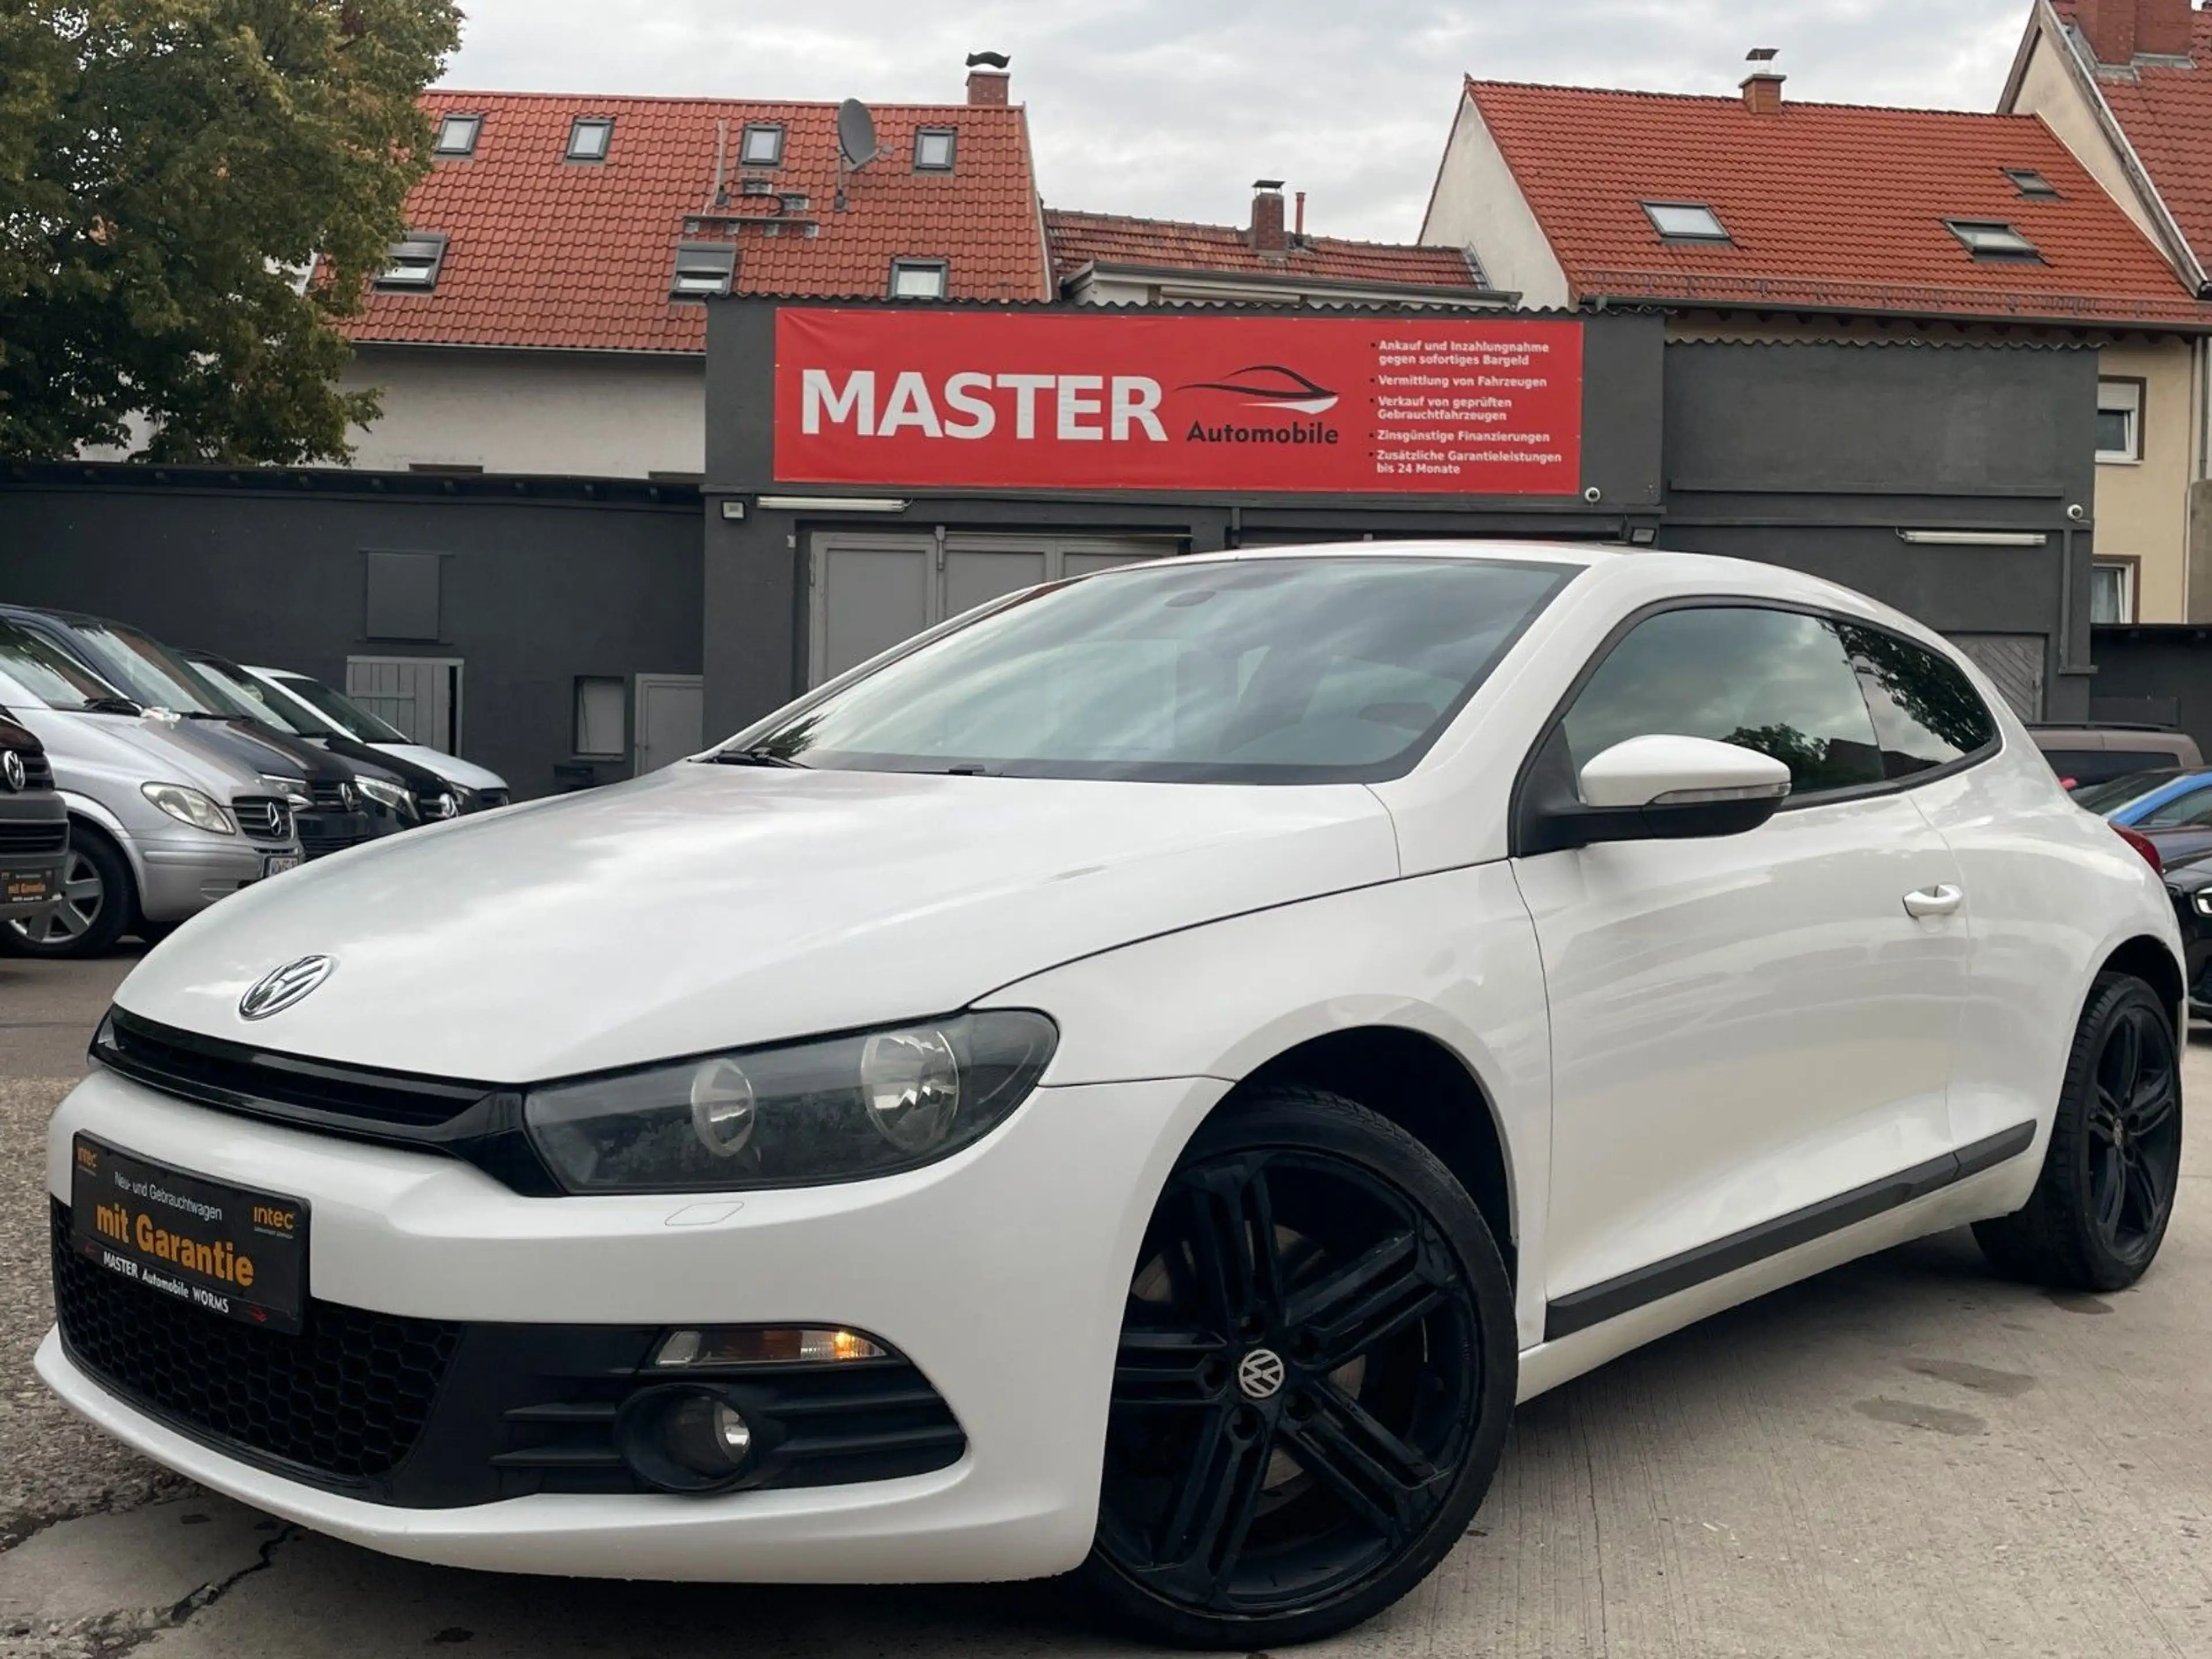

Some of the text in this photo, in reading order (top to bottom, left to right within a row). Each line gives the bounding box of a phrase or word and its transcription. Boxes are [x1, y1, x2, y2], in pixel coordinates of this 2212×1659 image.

[1378, 340, 1549, 354] Ankauf und Inzahlungnahme
[1379, 354, 1529, 366] gegen sofortiges Bargeld
[1378, 375, 1546, 389] Vermittlung von Fahrzeugen
[802, 369, 1168, 442] MASTER
[1378, 396, 1512, 409] Verkauf von geprüften
[1378, 410, 1506, 422] Gebrauchtfahrzeugen
[1186, 420, 1339, 444] Automobile
[1377, 430, 1550, 444] Zinsgünstige Finanzierungen
[1377, 450, 1562, 464] Zusätzliche Garantieleistungen
[1377, 463, 1460, 474] bis 24 Monate
[132, 1181, 147, 1197] und
[149, 1184, 222, 1221] Gebrauchtwagen
[97, 1203, 253, 1286] mit Garantie
[103, 1251, 229, 1313] MASTER Automobile WORMS
